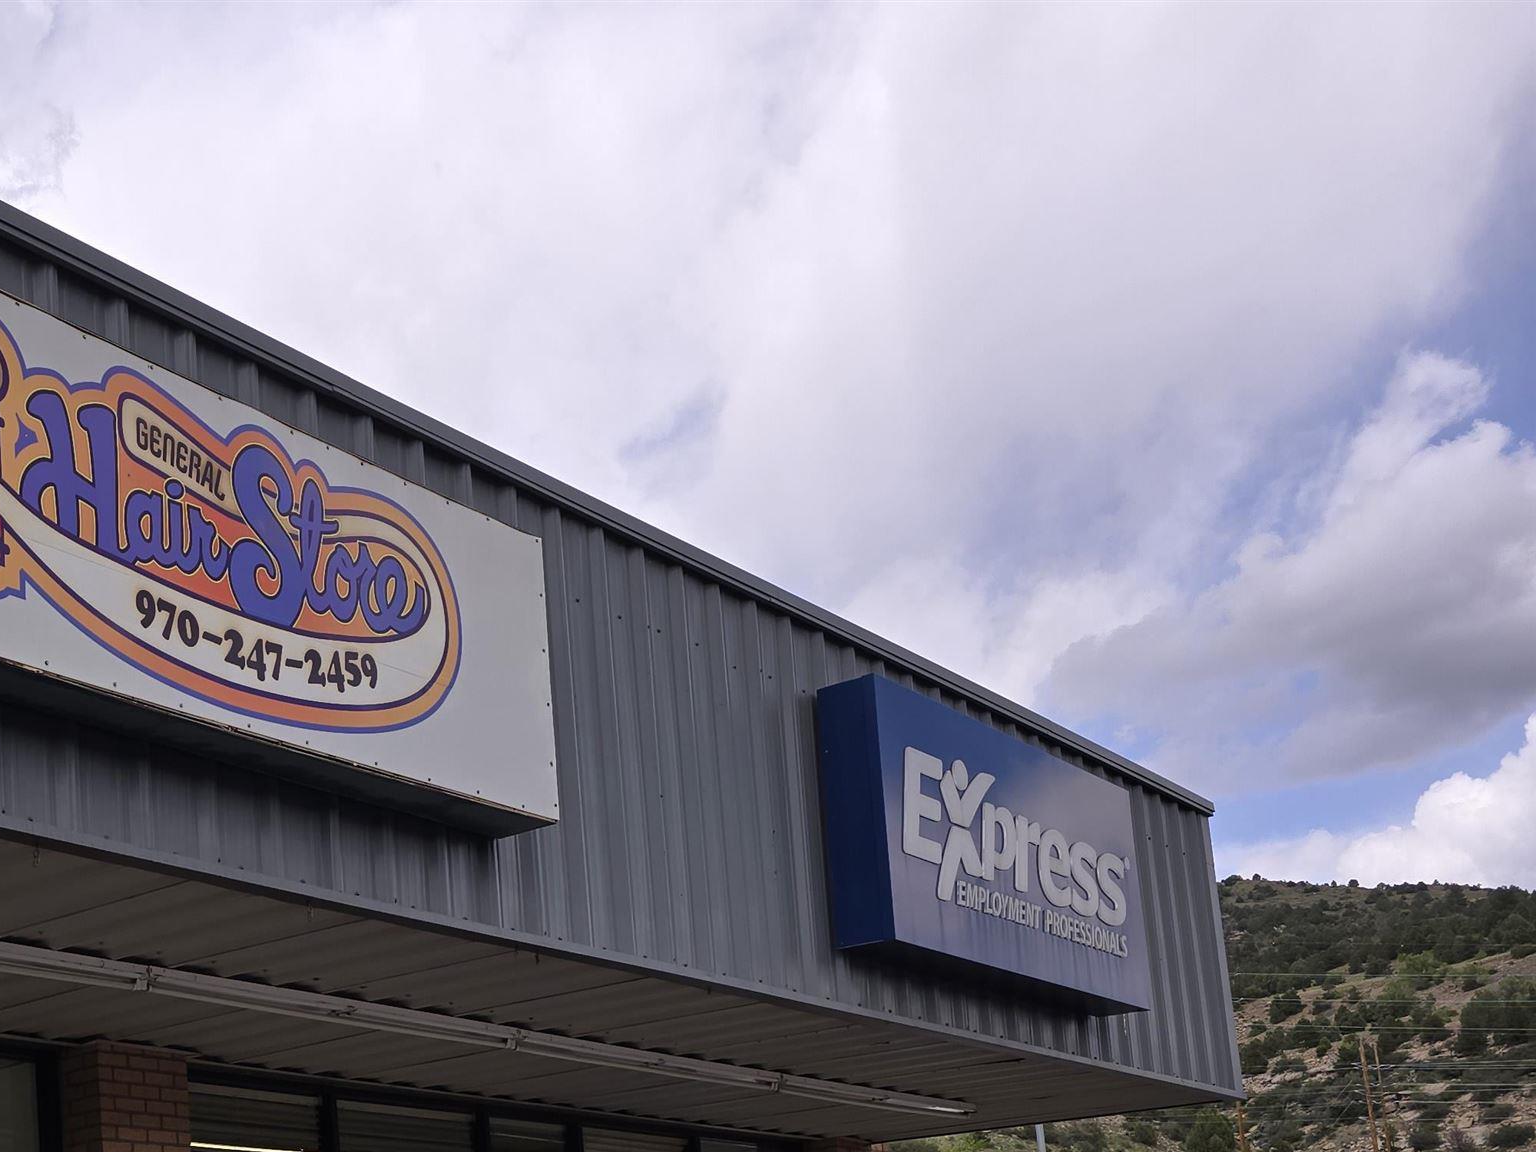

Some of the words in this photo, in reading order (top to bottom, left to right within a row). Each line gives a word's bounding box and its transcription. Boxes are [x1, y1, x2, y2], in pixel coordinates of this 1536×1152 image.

[136, 416, 226, 501] GENERAL
[20, 390, 230, 580] Hair
[228, 444, 429, 634] Store
[136, 590, 378, 692] 970-247-2459
[903, 746, 1128, 927] Express
[956, 881, 1042, 929] EMPLOYMENT
[1043, 909, 1128, 958] PROFESSIONALS
